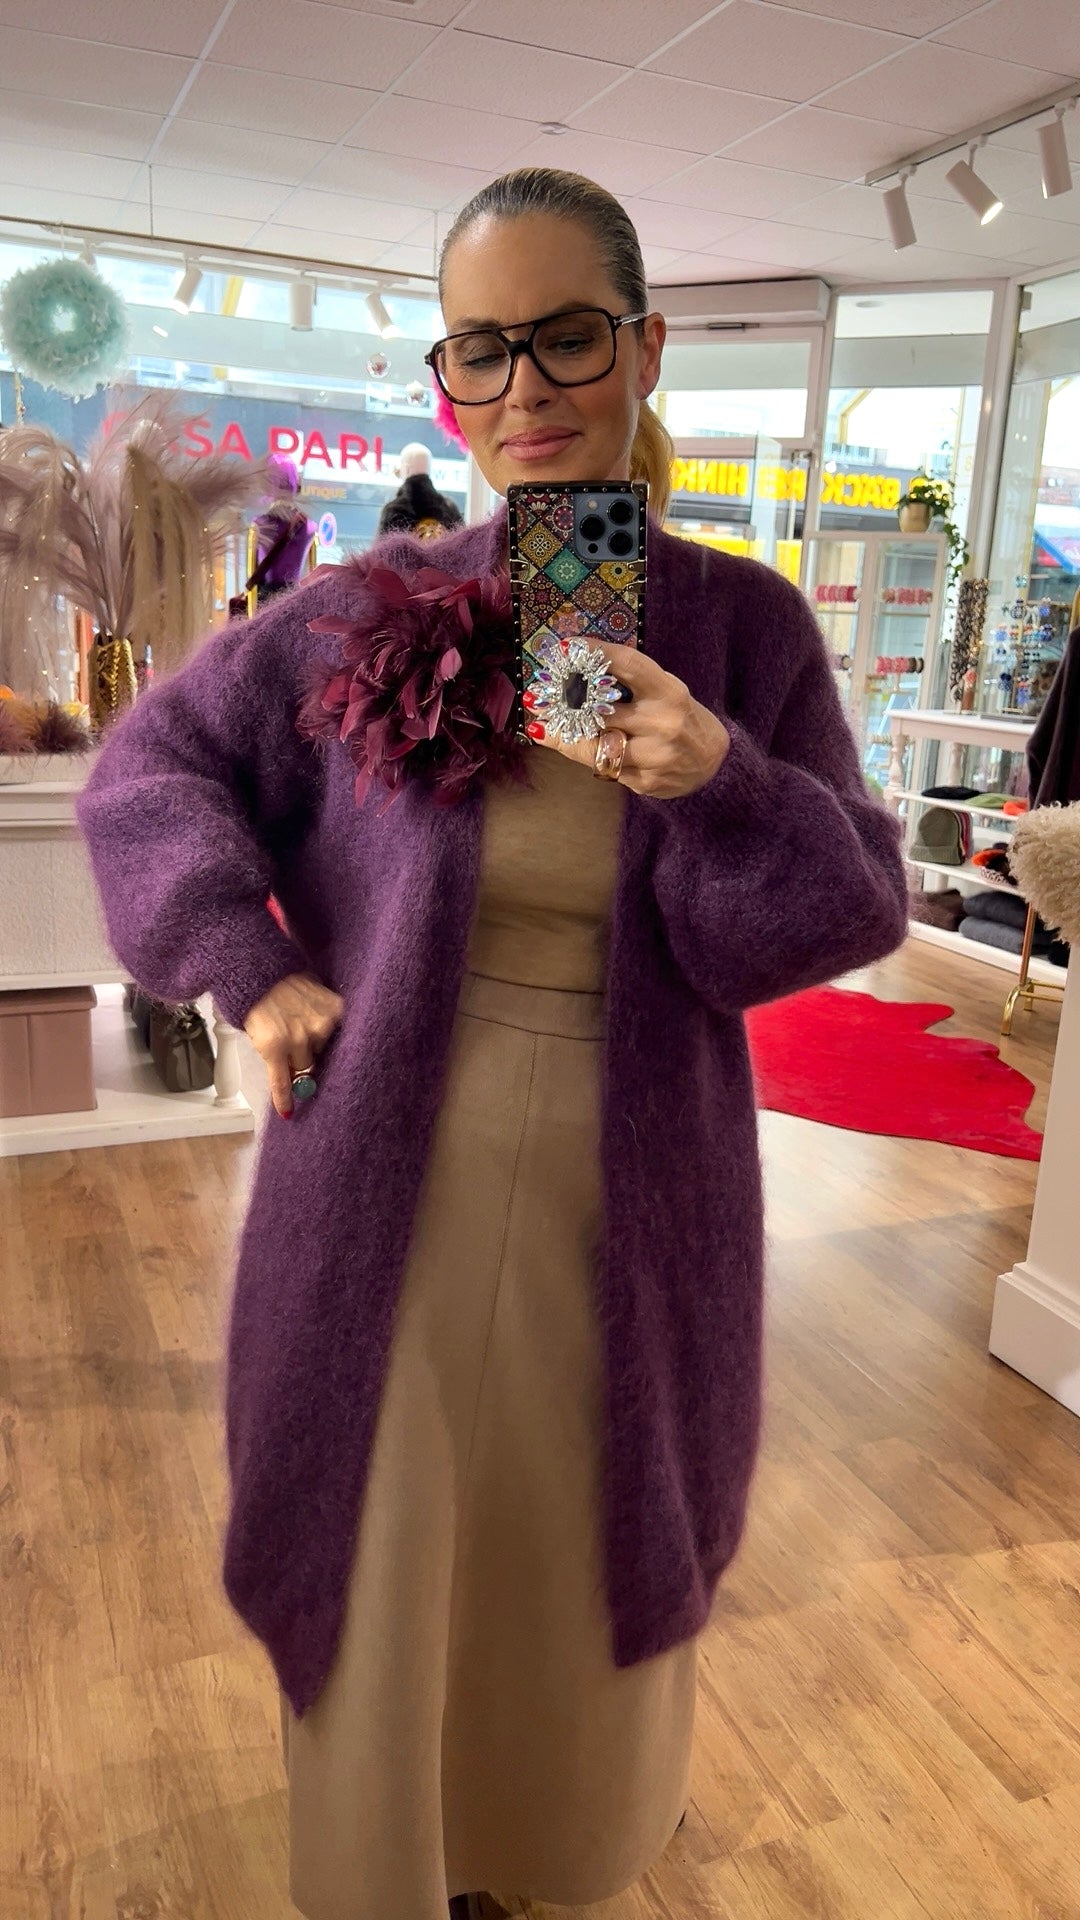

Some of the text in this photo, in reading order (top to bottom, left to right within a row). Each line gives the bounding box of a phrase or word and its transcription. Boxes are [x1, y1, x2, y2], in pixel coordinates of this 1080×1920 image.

[102, 411, 384, 473] CSA PARI
[301, 485, 347, 500] UTIQUE
